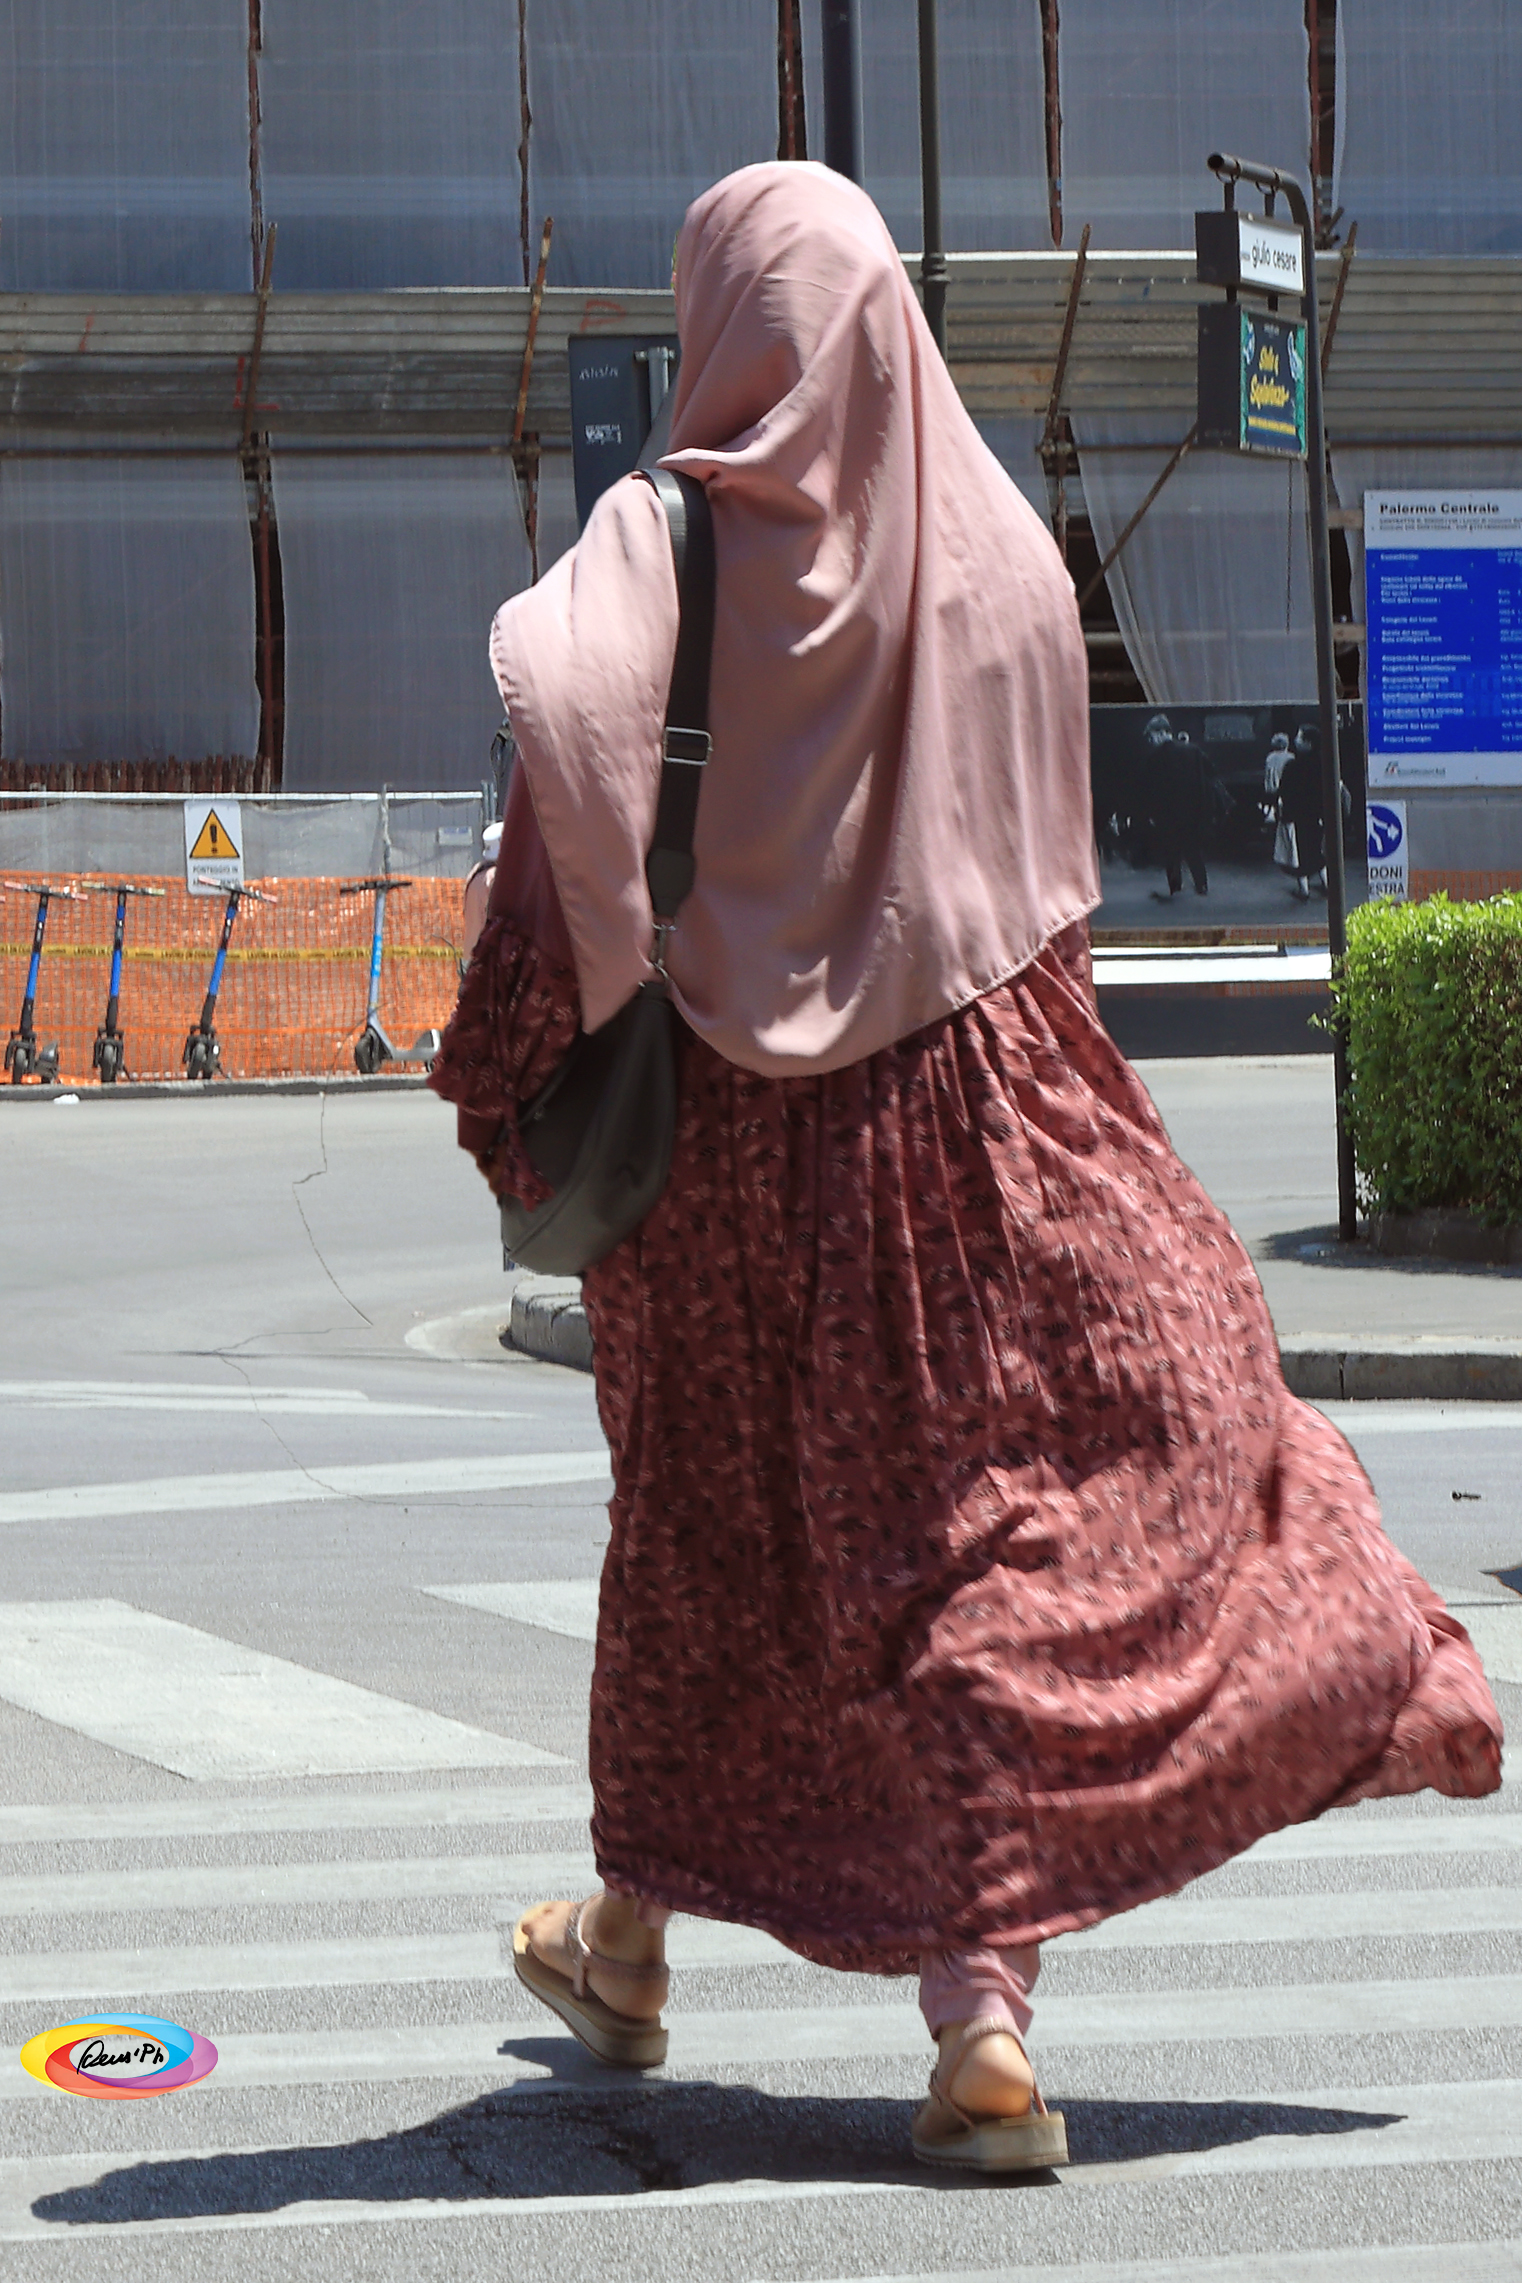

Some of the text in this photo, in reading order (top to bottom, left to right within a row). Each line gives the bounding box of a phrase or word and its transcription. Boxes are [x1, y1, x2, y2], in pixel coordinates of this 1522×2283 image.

[1273, 249, 1296, 272] cesare
[1380, 502, 1499, 514] Palermo Centrale
[1370, 866, 1402, 879] DONI
[1369, 883, 1404, 895] ESTRA
